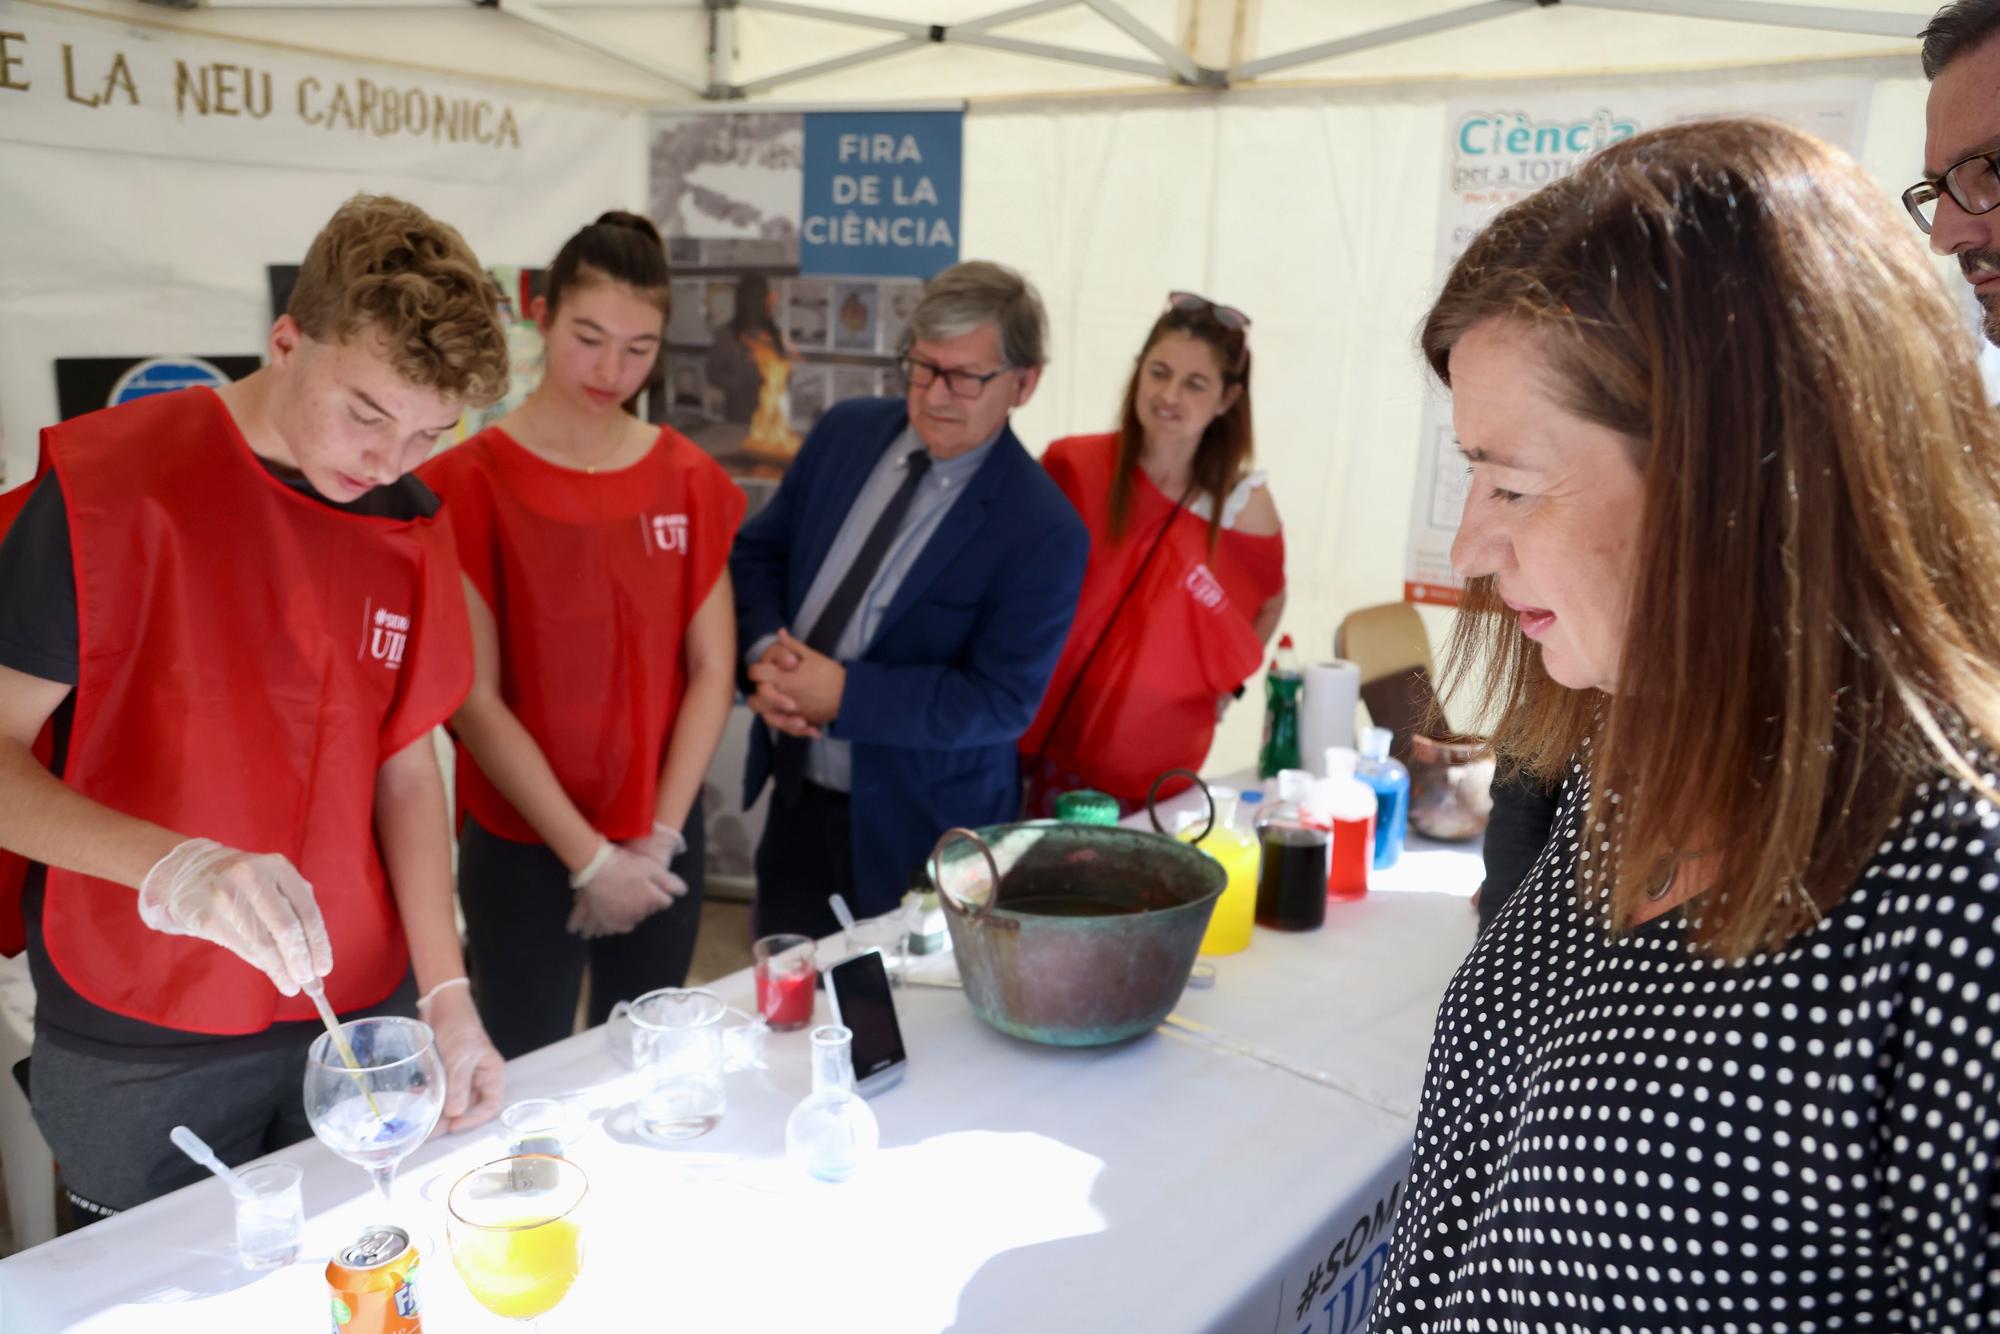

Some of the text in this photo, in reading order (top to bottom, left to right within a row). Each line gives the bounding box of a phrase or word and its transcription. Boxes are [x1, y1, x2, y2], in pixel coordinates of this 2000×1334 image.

[61, 44, 140, 108] LA
[175, 57, 273, 122] NEU
[295, 75, 521, 149] CARBONICA
[838, 133, 923, 164] FIRA
[832, 175, 939, 206] DE LA
[803, 209, 954, 247] CIÈNCIA
[1297, 1181, 1400, 1320] #SOM
